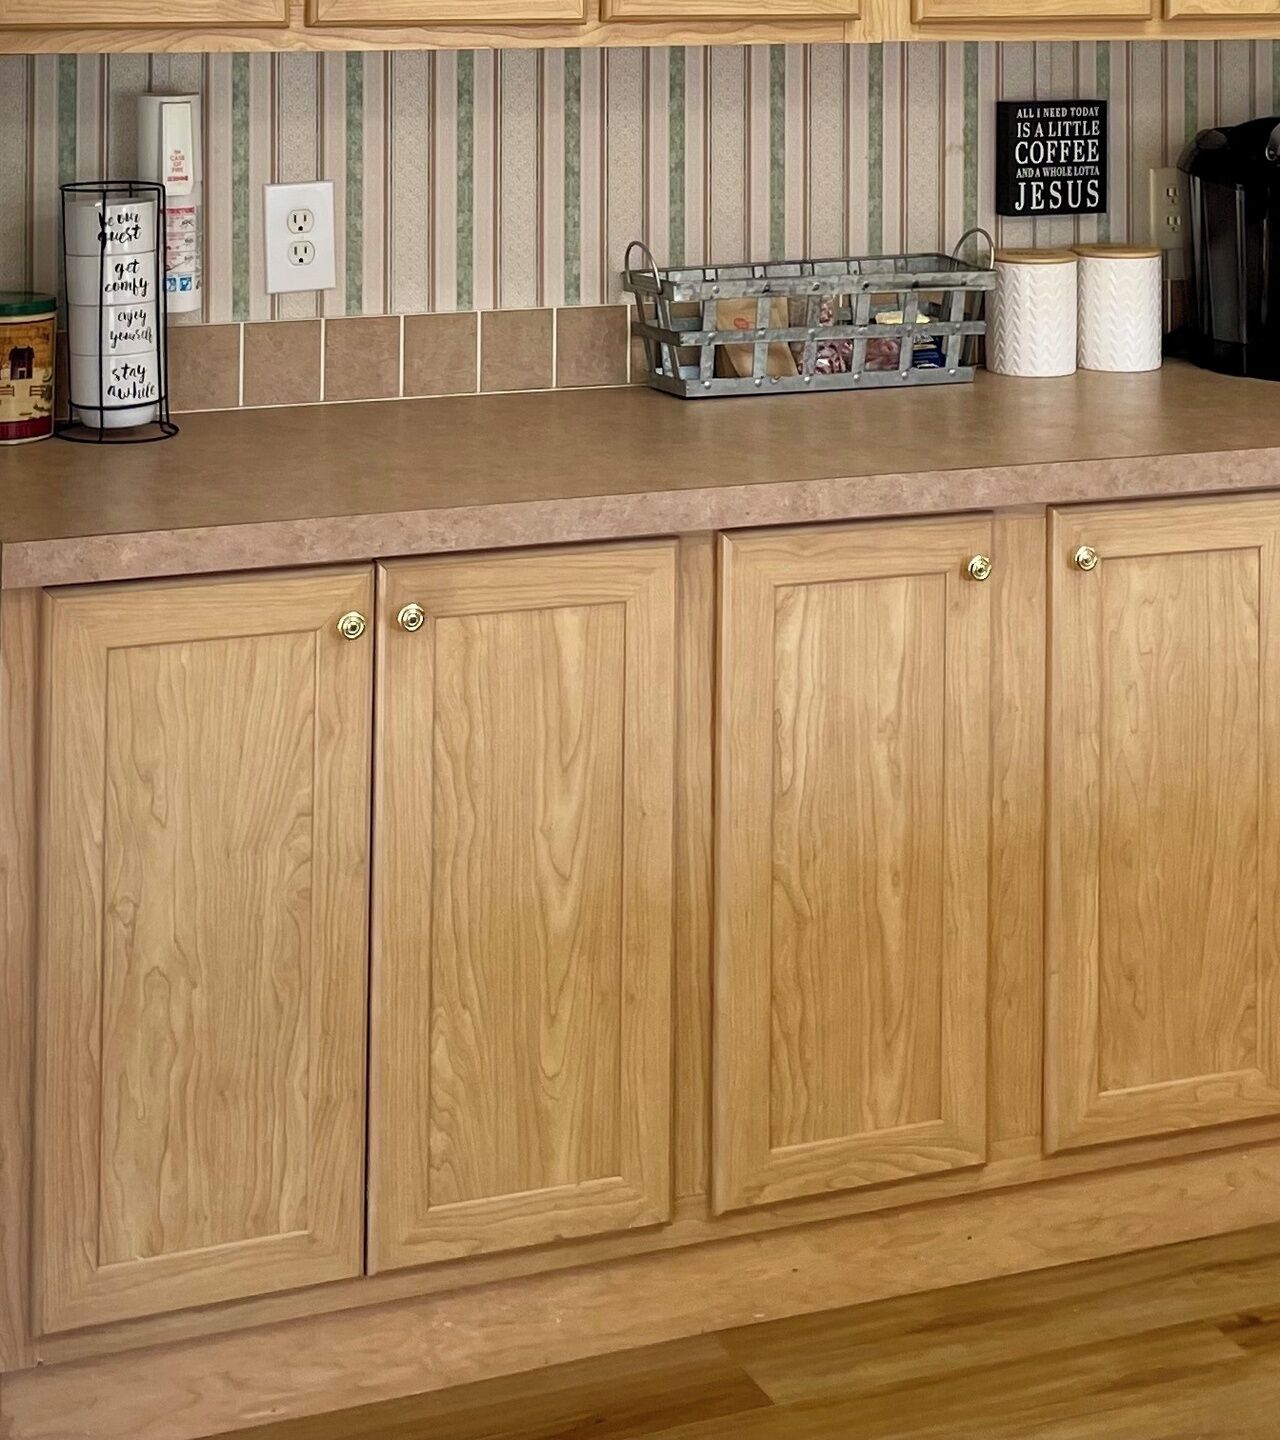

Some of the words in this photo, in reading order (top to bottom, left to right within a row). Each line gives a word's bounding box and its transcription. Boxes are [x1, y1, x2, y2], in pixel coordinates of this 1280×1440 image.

[1016, 108, 1034, 118] ALL
[1036, 107, 1040, 118] I
[1043, 107, 1067, 118] NEED
[1070, 106, 1100, 117] TODAY
[1017, 122, 1031, 138] IS
[1034, 121, 1044, 138] A
[1048, 120, 1100, 137] LITTLE
[1015, 139, 1100, 164] COFFEE
[1016, 167, 1034, 178] AND
[1035, 167, 1041, 178] A
[1042, 166, 1072, 177] WHOLE
[1074, 165, 1100, 176] LOTTA
[1015, 179, 1099, 211] JESUS
[114, 259, 140, 281] get
[104, 277, 148, 297] comfy
[112, 363, 145, 384] stay
[107, 381, 155, 399] awhile
